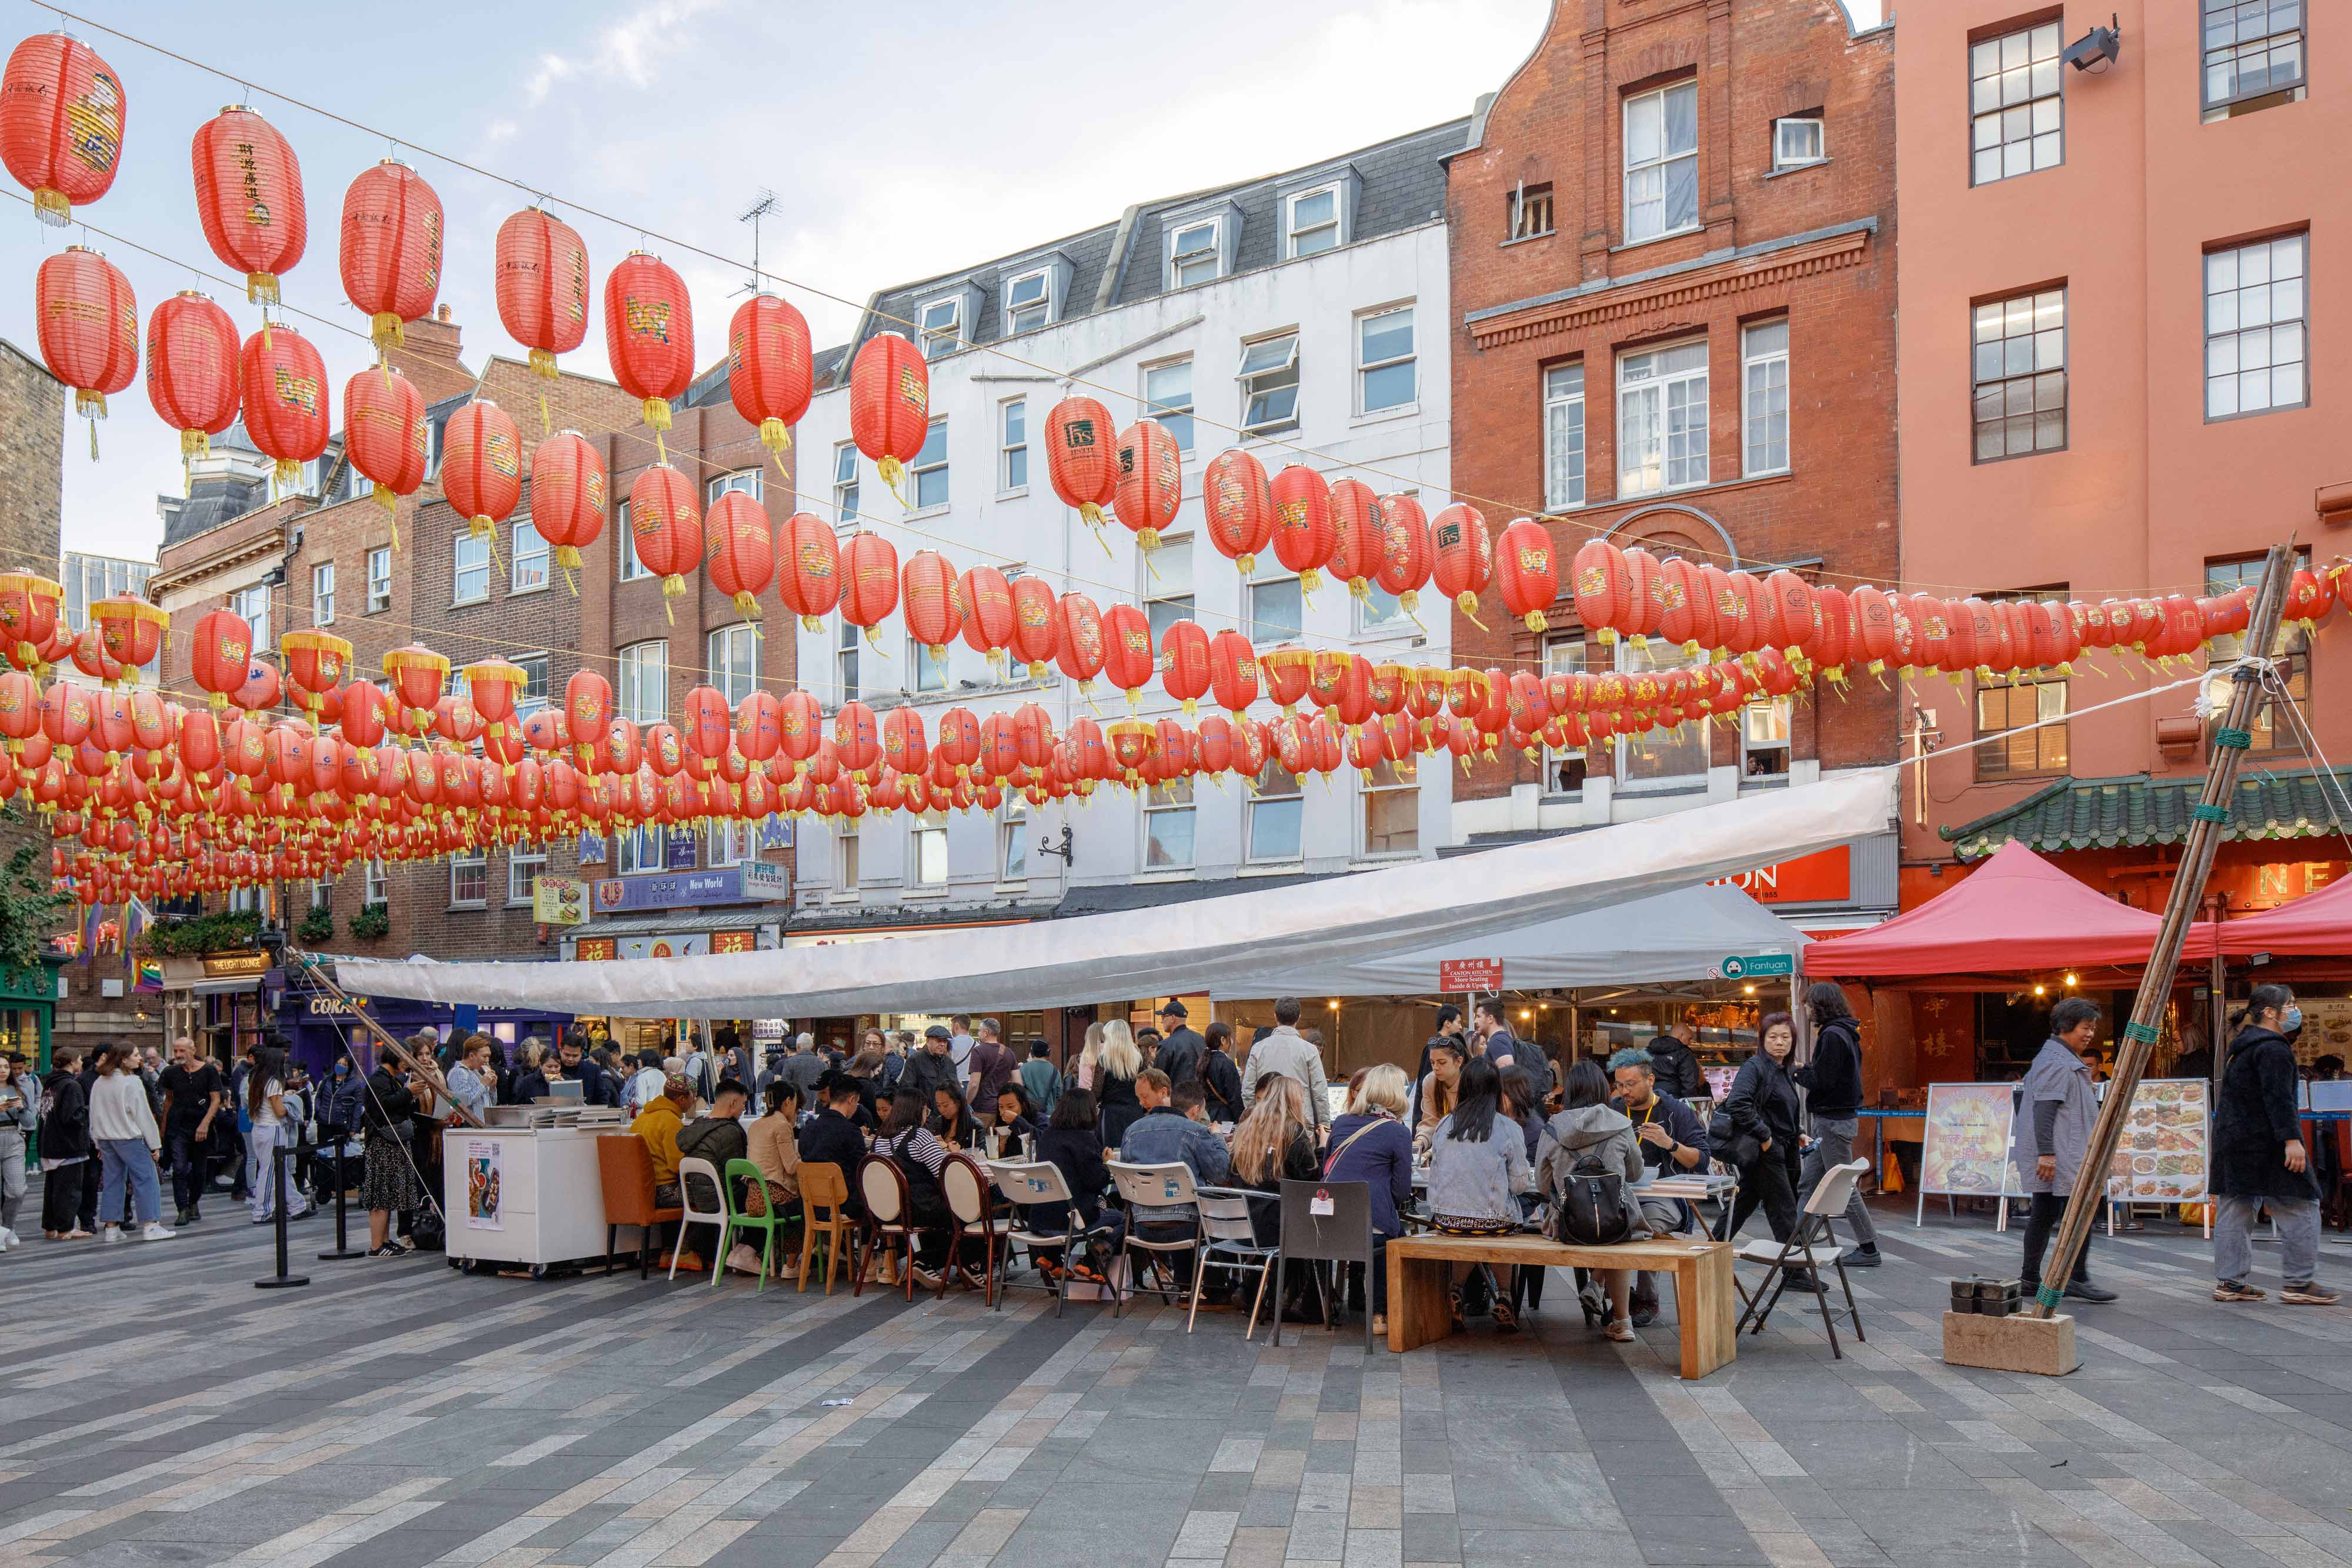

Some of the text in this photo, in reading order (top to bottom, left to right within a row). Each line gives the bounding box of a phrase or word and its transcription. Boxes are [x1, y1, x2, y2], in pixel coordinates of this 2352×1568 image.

[239, 144, 260, 200] 財源廣進
[690, 877, 723, 889] New World
[213, 959, 261, 969] THE LIGHT LOUNGE
[1750, 961, 1787, 970] Fantuan
